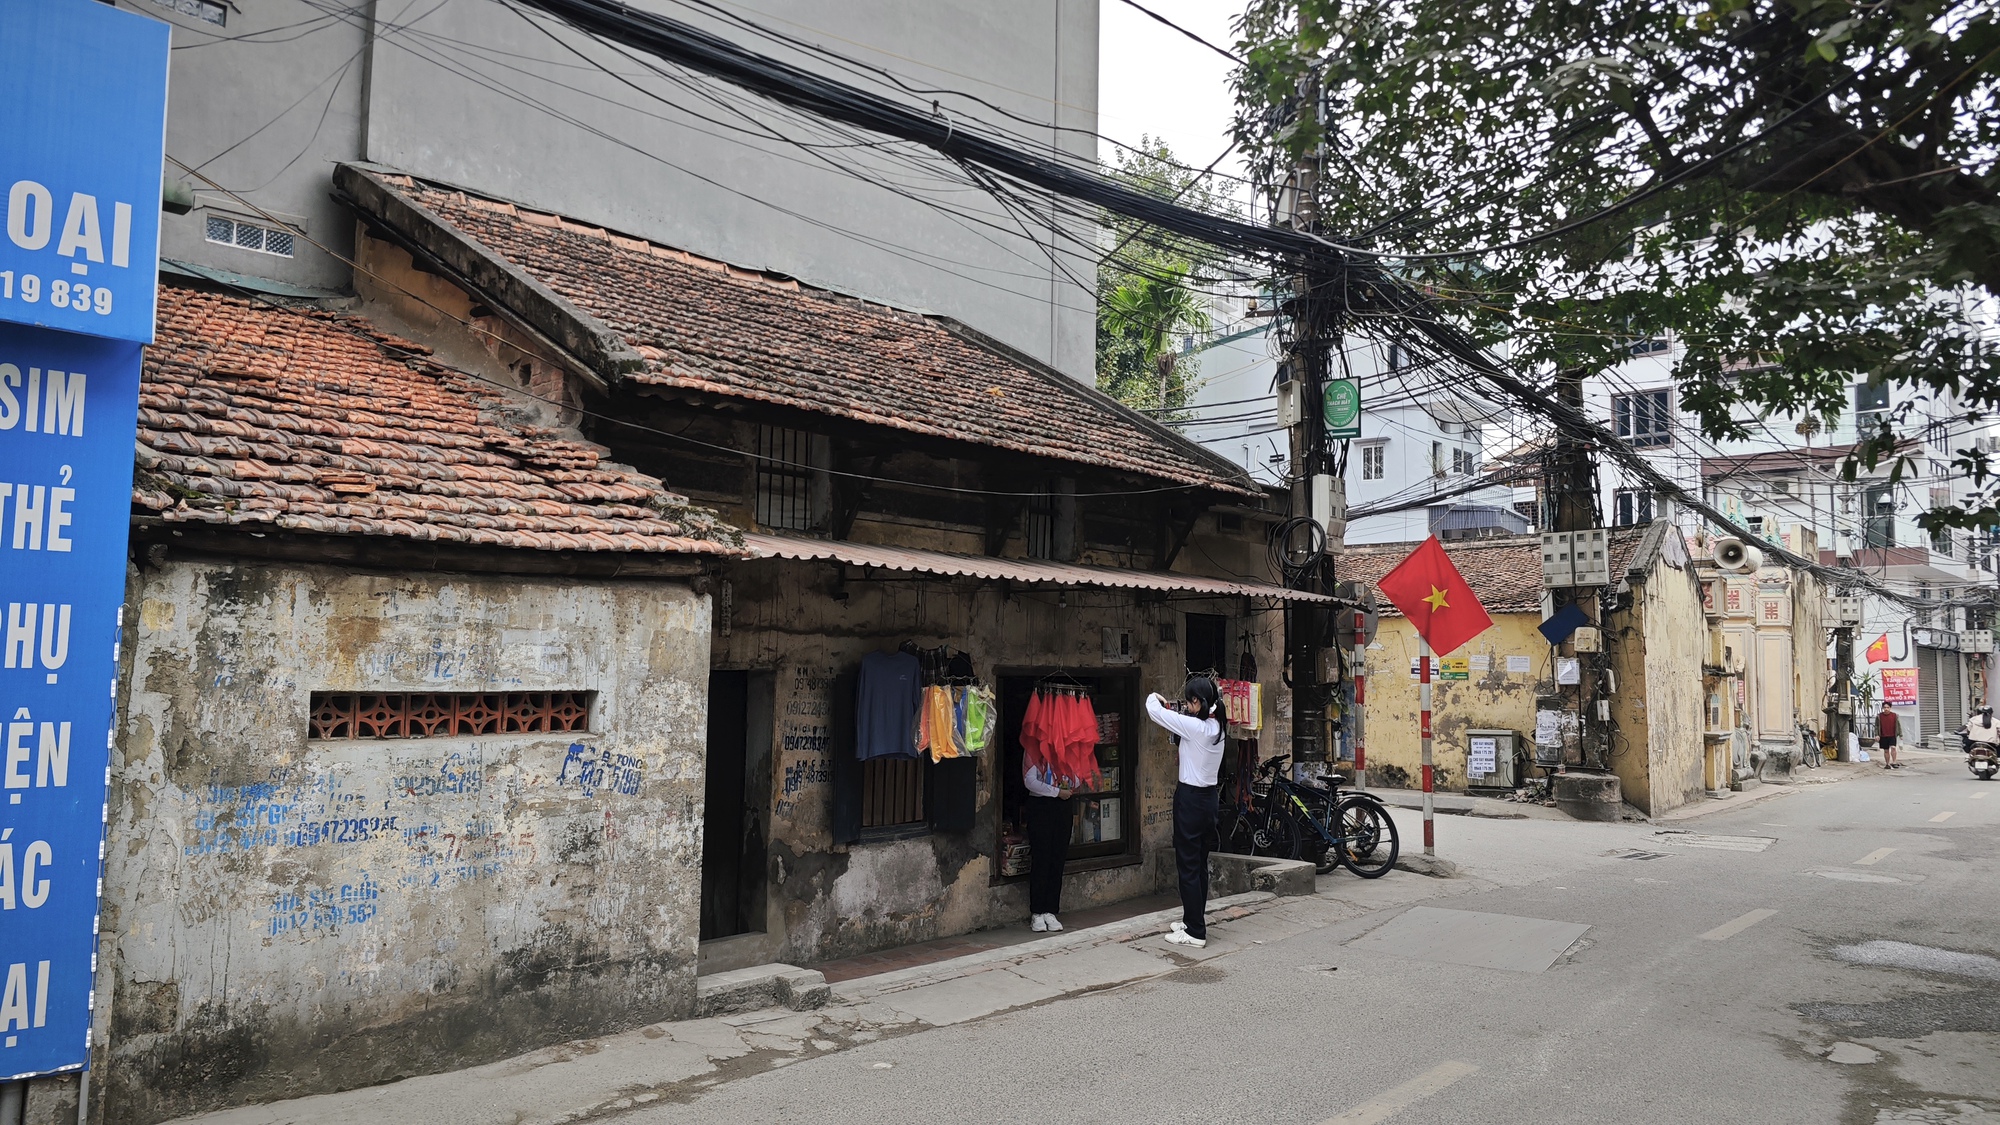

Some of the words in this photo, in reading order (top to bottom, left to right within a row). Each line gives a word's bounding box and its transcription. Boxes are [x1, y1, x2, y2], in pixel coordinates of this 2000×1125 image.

[7, 180, 132, 276] OẠI
[51, 279, 113, 316] 839
[0, 363, 87, 437] SIM
[0, 602, 72, 685] HỤ
[0, 707, 72, 804] ỆN
